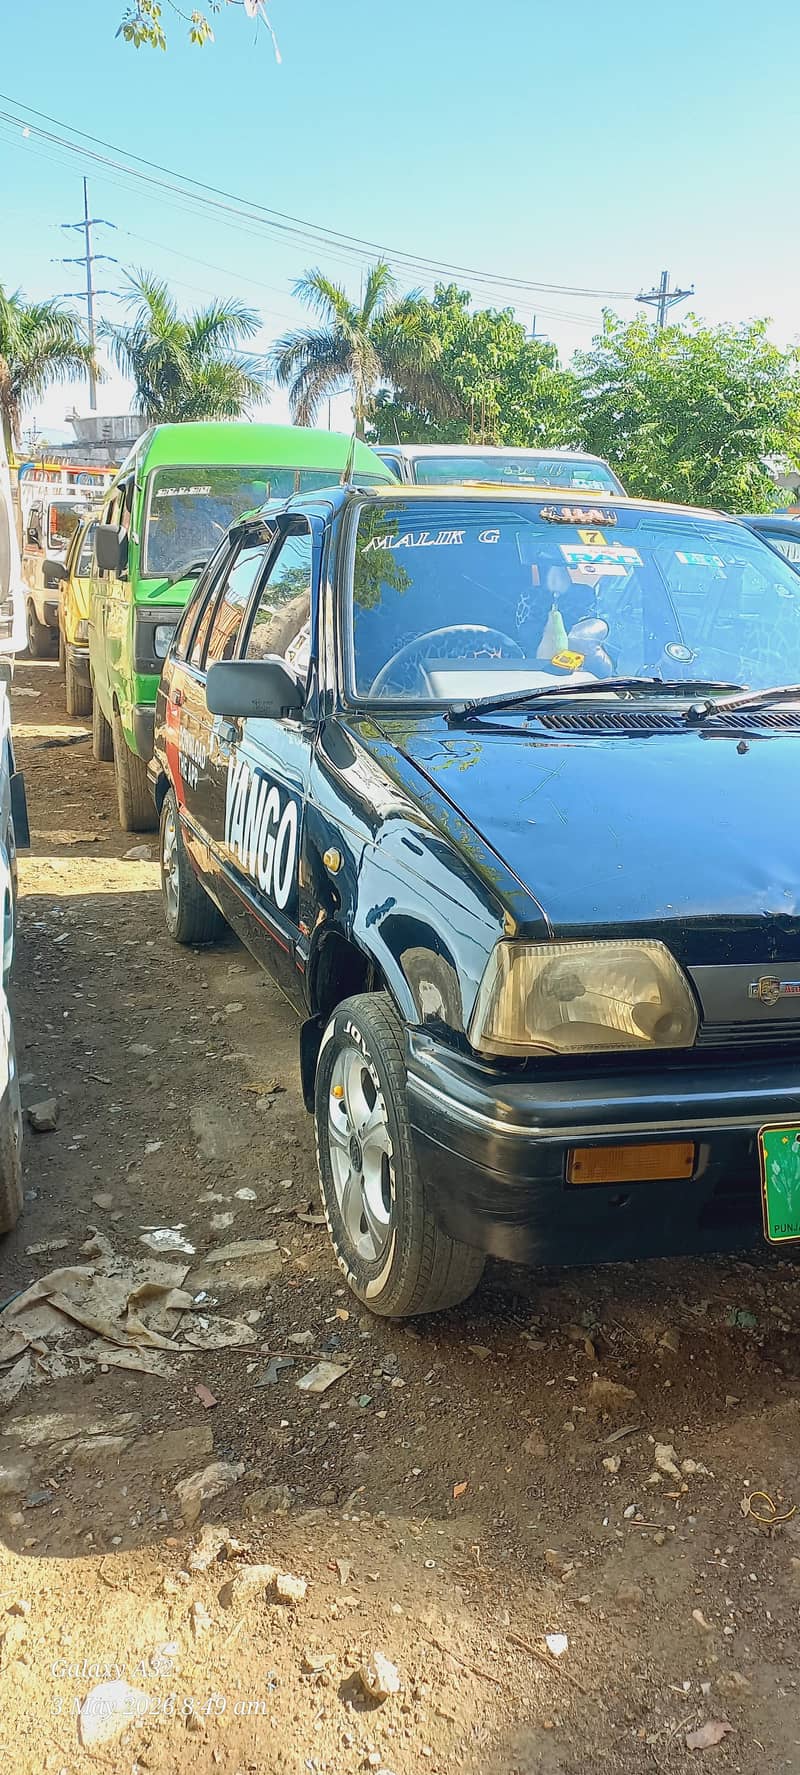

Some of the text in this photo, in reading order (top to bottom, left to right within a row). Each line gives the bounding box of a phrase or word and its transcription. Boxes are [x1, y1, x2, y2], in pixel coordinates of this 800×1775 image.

[361, 529, 501, 553] MALIK G
[585, 532, 599, 544] 7
[224, 757, 298, 909] YANGO
[774, 1222, 800, 1234] PUNJ
